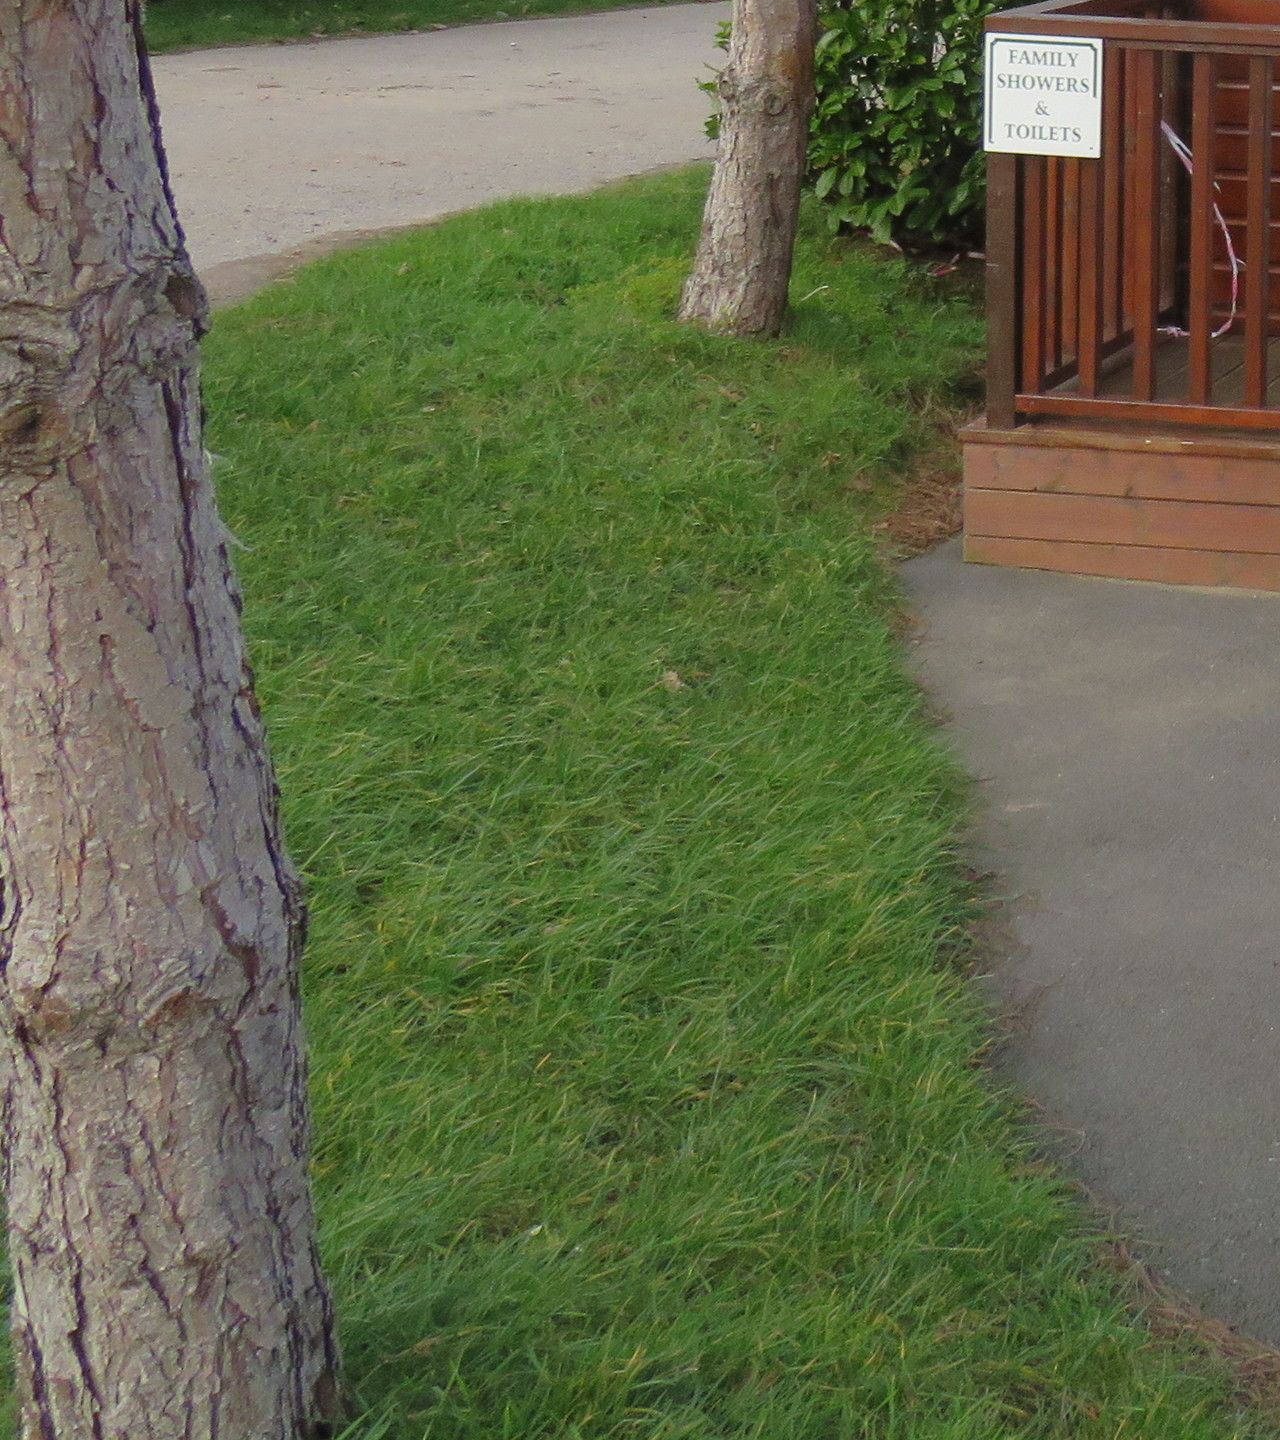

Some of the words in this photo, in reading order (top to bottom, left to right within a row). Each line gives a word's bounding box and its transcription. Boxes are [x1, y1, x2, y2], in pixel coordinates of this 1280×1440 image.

[1008, 48, 1080, 68] FAMILY
[996, 72, 1090, 94] SHOWERS
[1034, 100, 1051, 117] &
[1003, 123, 1082, 143] TOILETS
